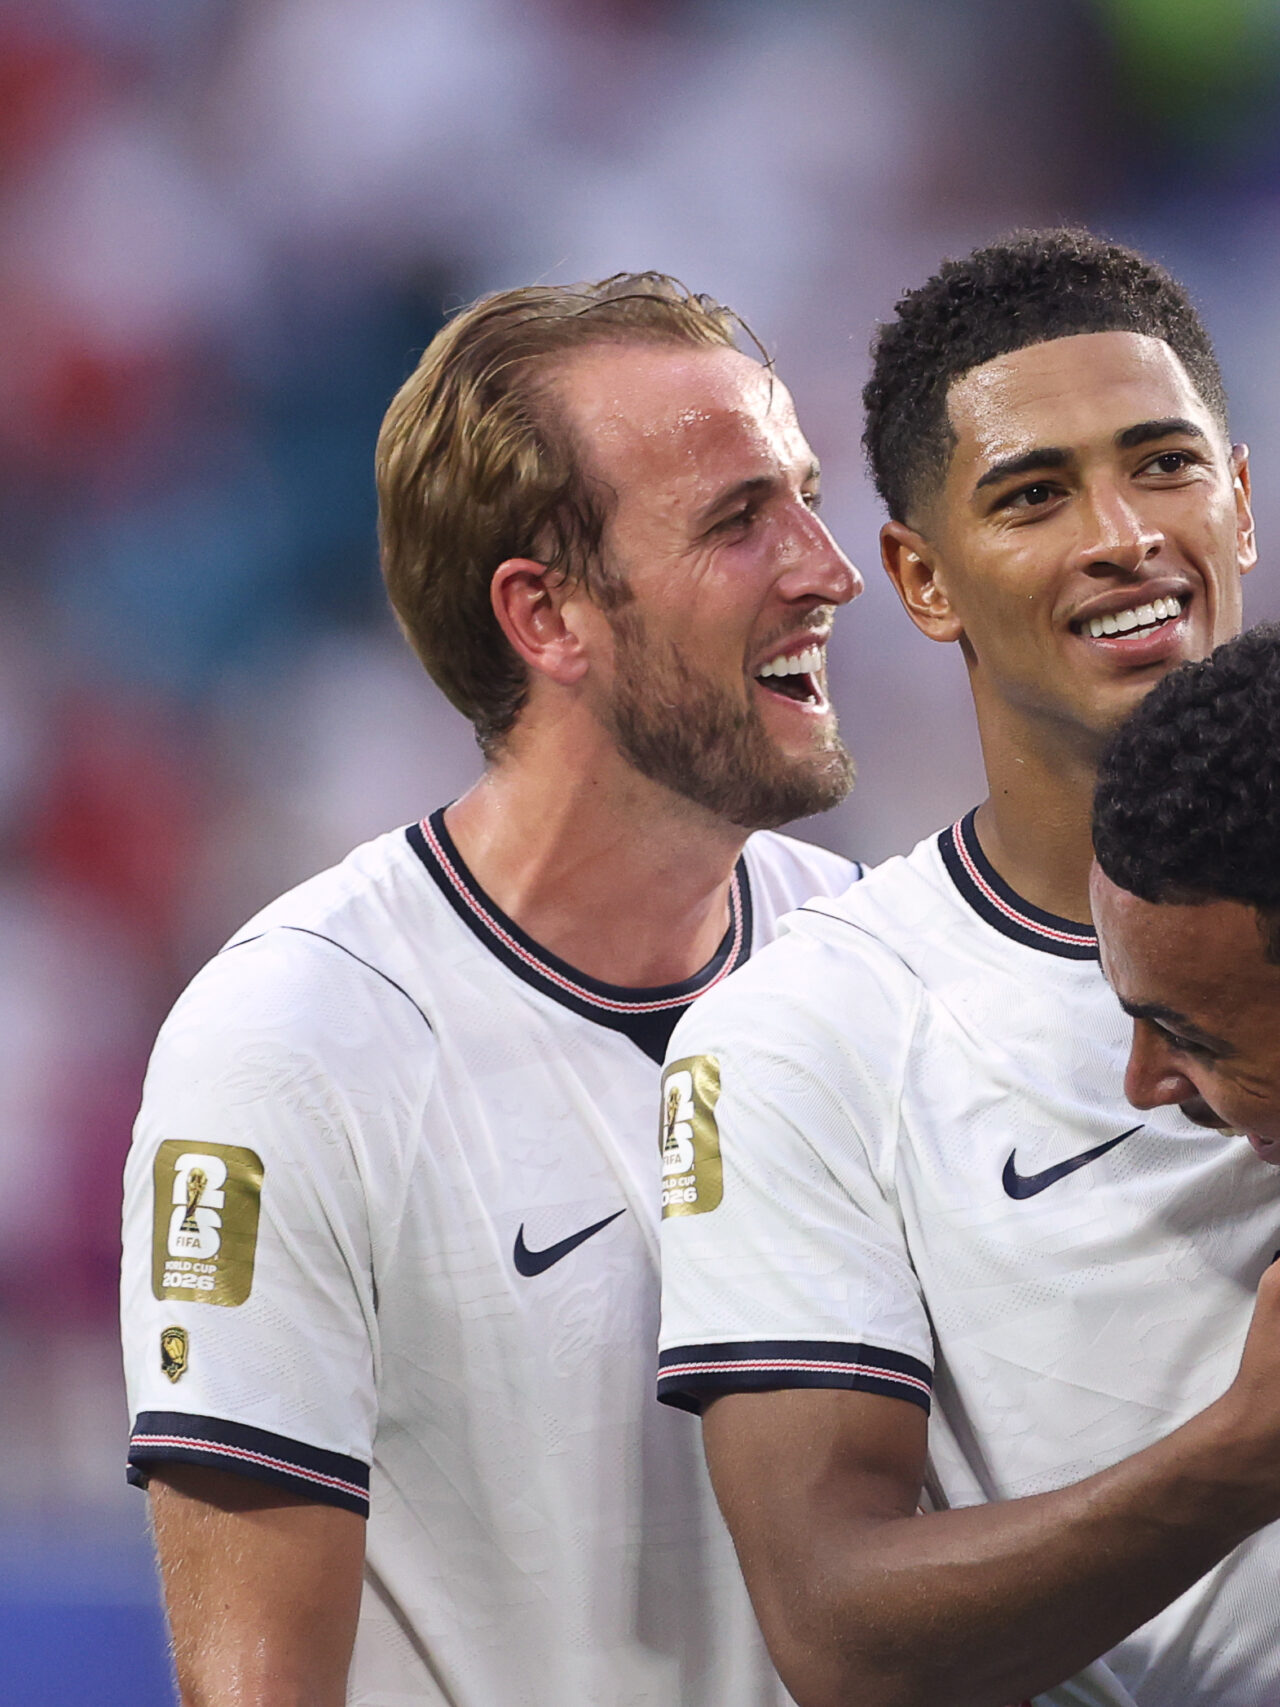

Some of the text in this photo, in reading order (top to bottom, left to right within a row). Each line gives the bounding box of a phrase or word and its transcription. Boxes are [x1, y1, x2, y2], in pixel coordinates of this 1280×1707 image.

[677, 1175, 696, 1187] CUP
[662, 1186, 698, 1207] 026
[176, 1235, 202, 1249] FIFA
[192, 1262, 218, 1274] CUP
[162, 1271, 216, 1292] 2026
